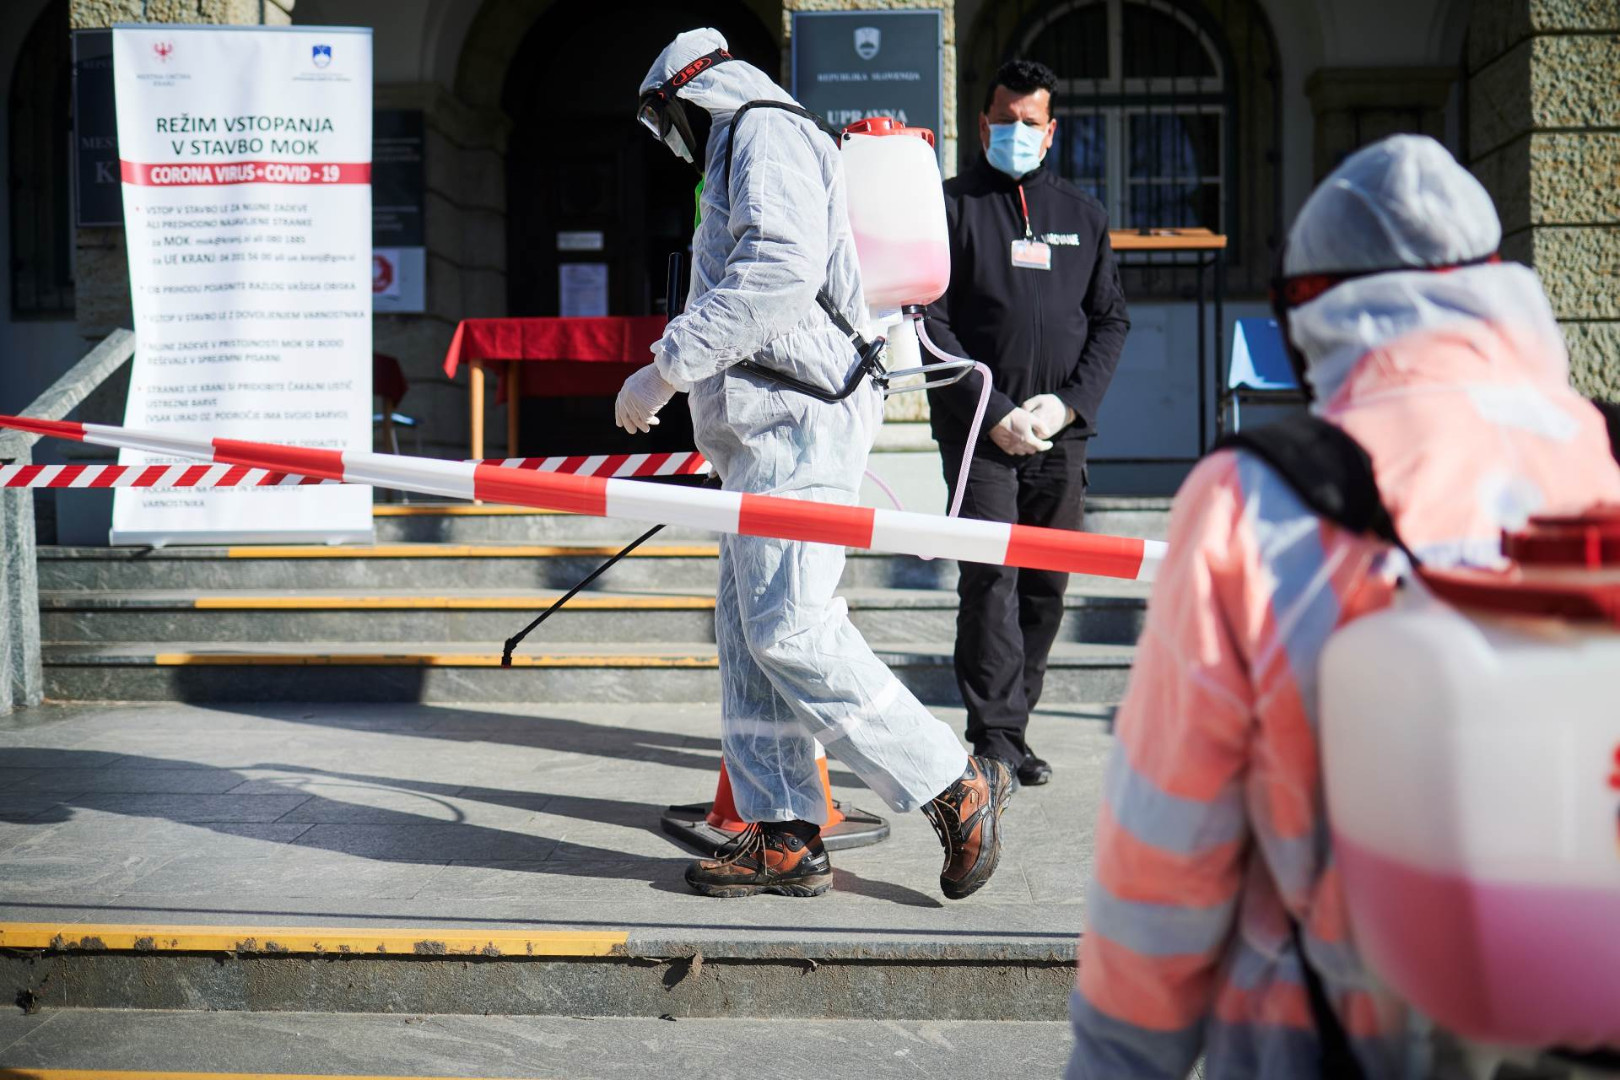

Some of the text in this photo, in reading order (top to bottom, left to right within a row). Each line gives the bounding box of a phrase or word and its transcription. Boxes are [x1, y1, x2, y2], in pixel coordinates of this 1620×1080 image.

[680, 59, 704, 82] JSP
[156, 113, 334, 133] REŽIM VSTOPANJA
[172, 138, 318, 155] V STAVBO MOK
[150, 165, 213, 184] CORONA
[322, 164, 340, 182] 19
